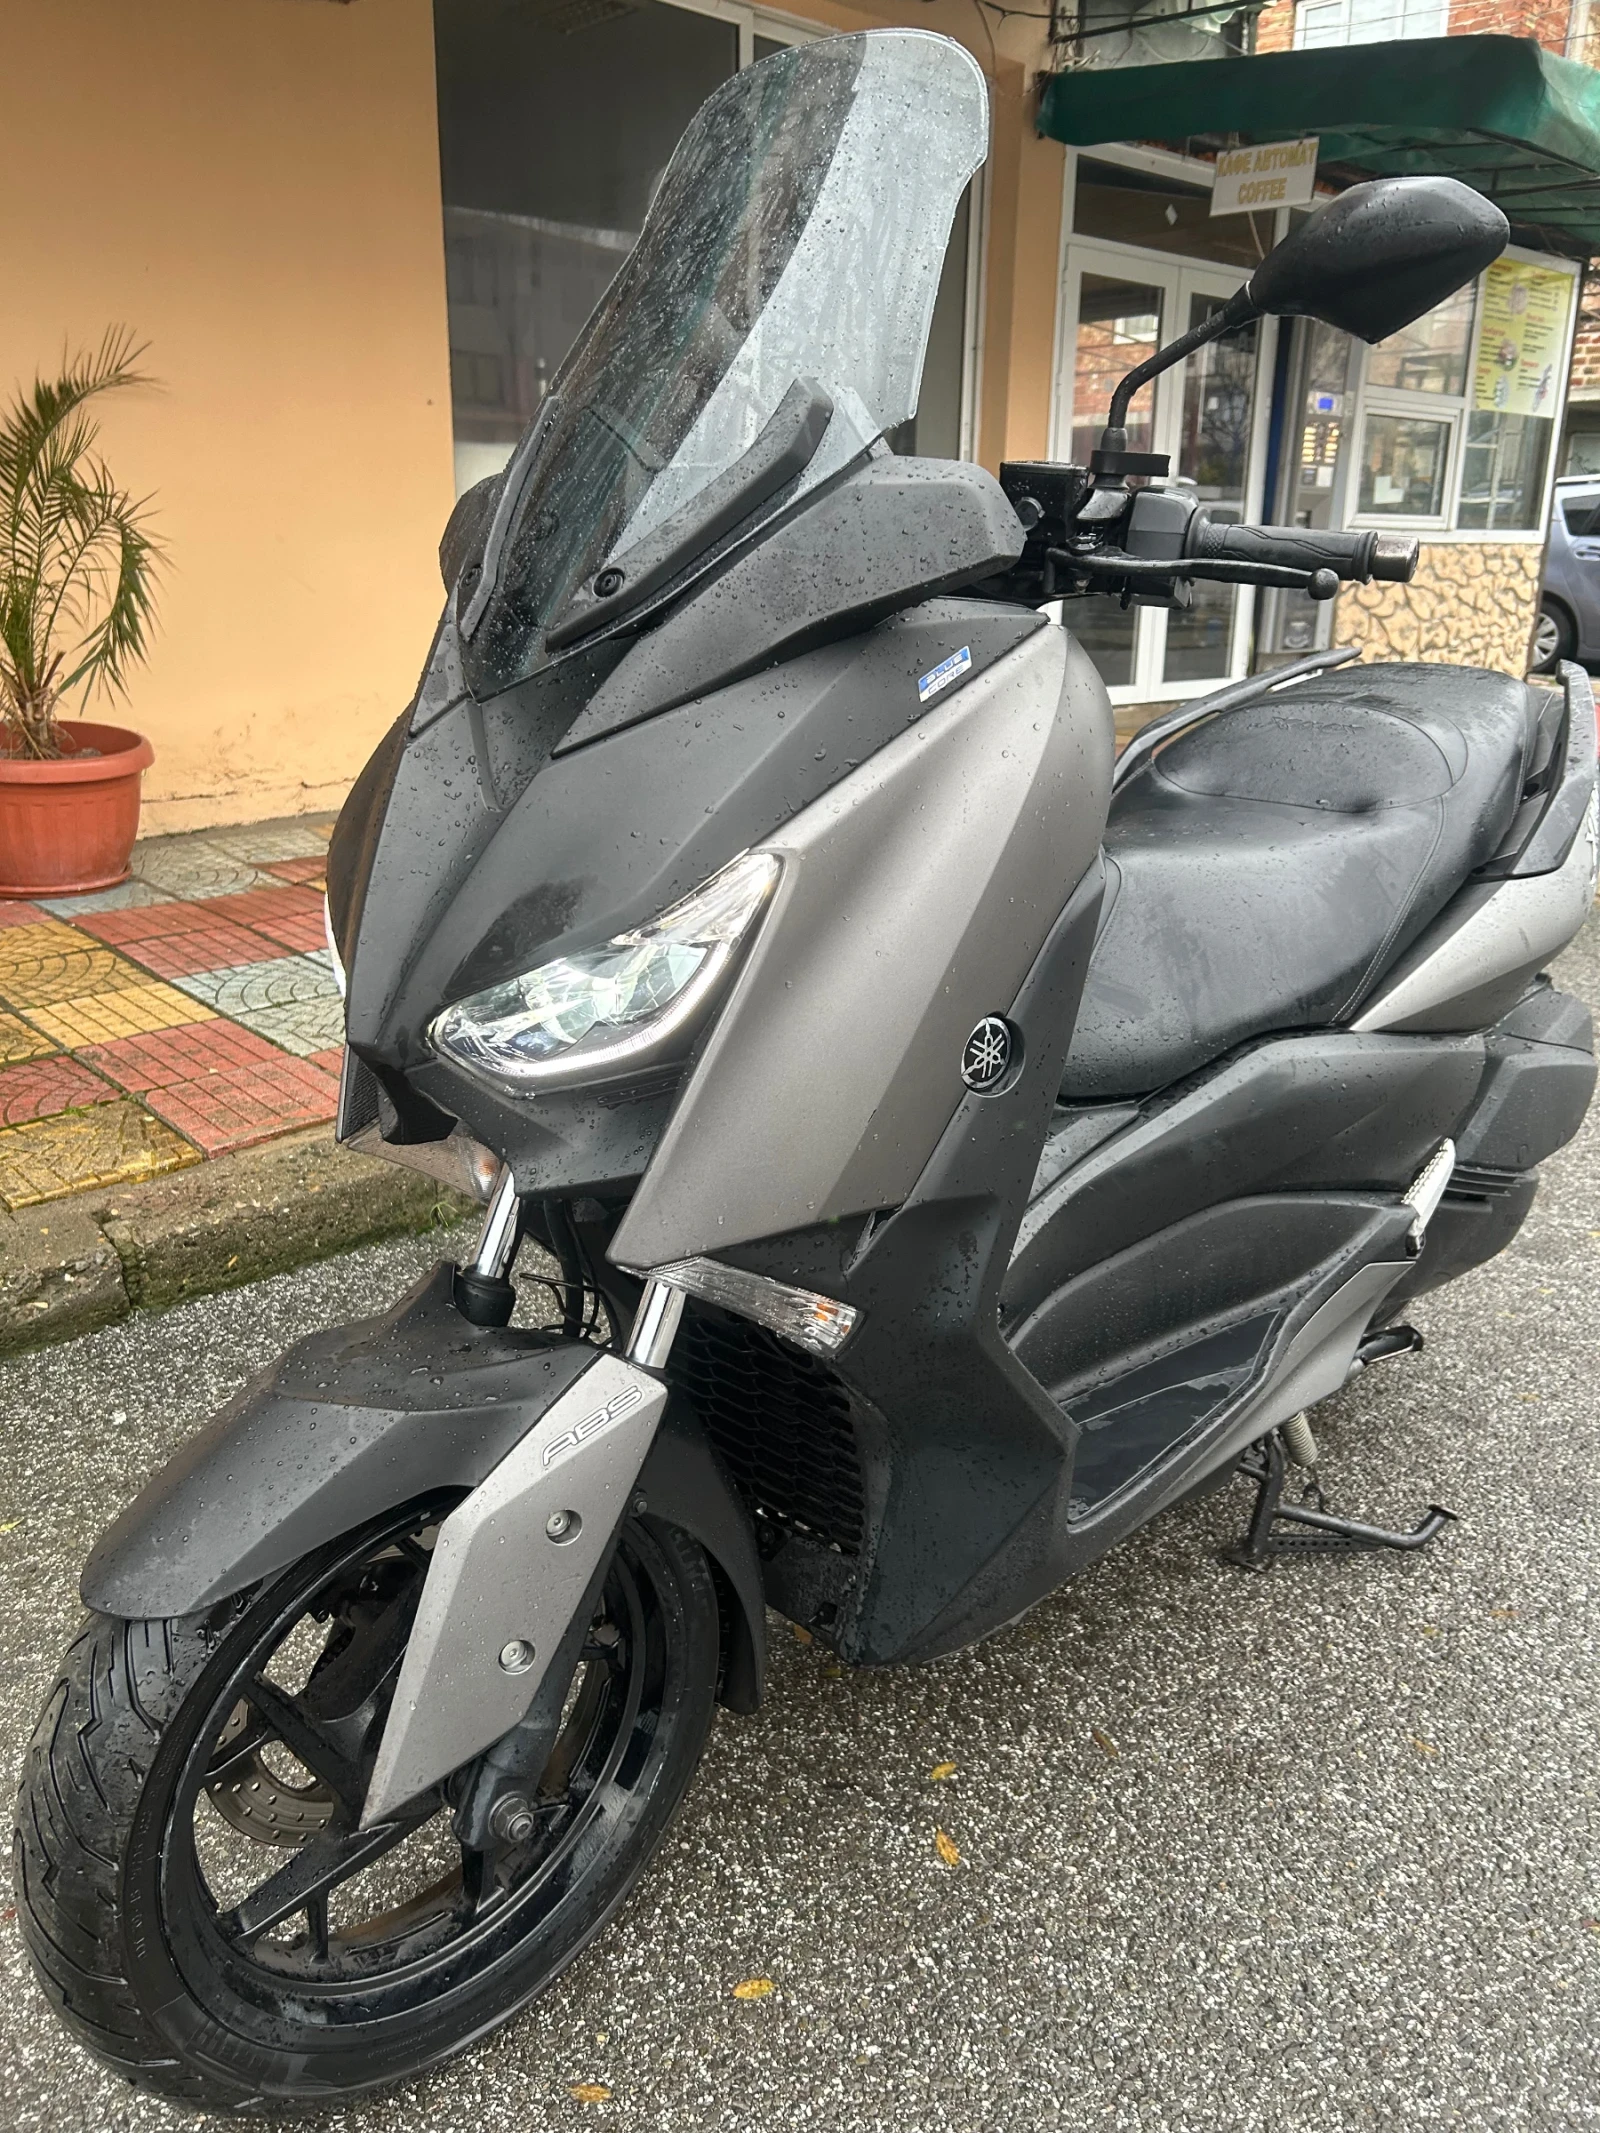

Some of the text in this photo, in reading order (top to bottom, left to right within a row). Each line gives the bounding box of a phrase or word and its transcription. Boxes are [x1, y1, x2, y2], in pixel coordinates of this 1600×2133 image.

[1238, 177, 1287, 204] COFFEE
[925, 653, 963, 684] BLUE
[928, 665, 964, 694] CORE
[543, 1384, 643, 1467] ABS
